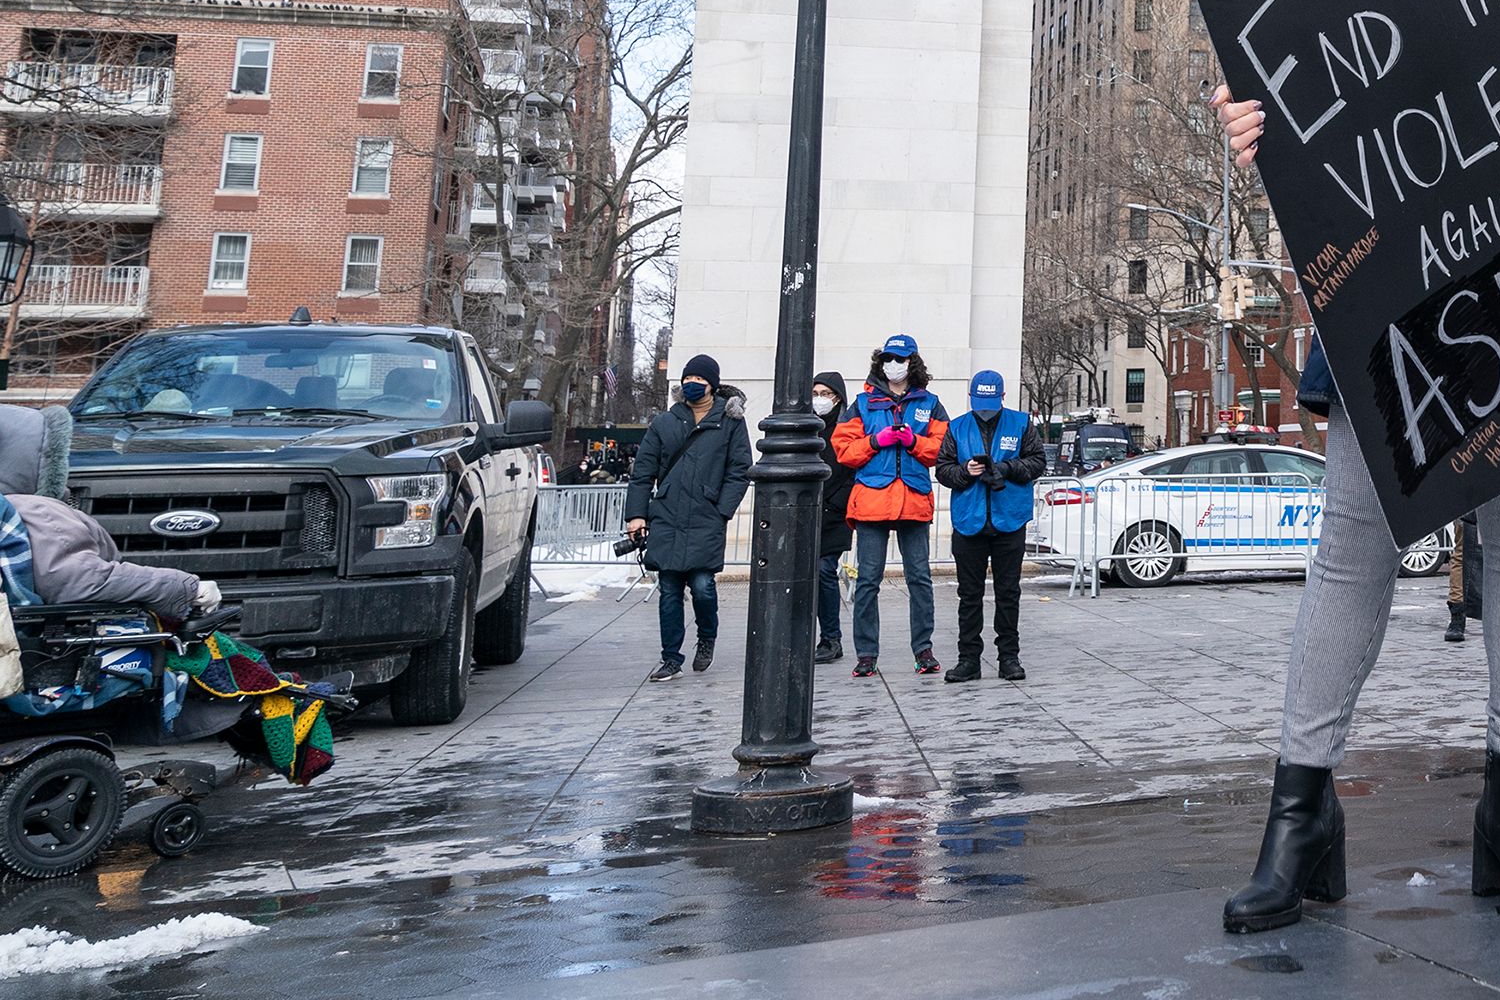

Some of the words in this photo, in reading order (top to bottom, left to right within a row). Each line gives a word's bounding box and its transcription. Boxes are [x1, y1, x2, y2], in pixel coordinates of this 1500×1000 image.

[1302, 243, 1343, 287] VICHA
[1450, 420, 1500, 474] Christian
[166, 515, 202, 531] Ford
[108, 660, 142, 672] PRIORITY
